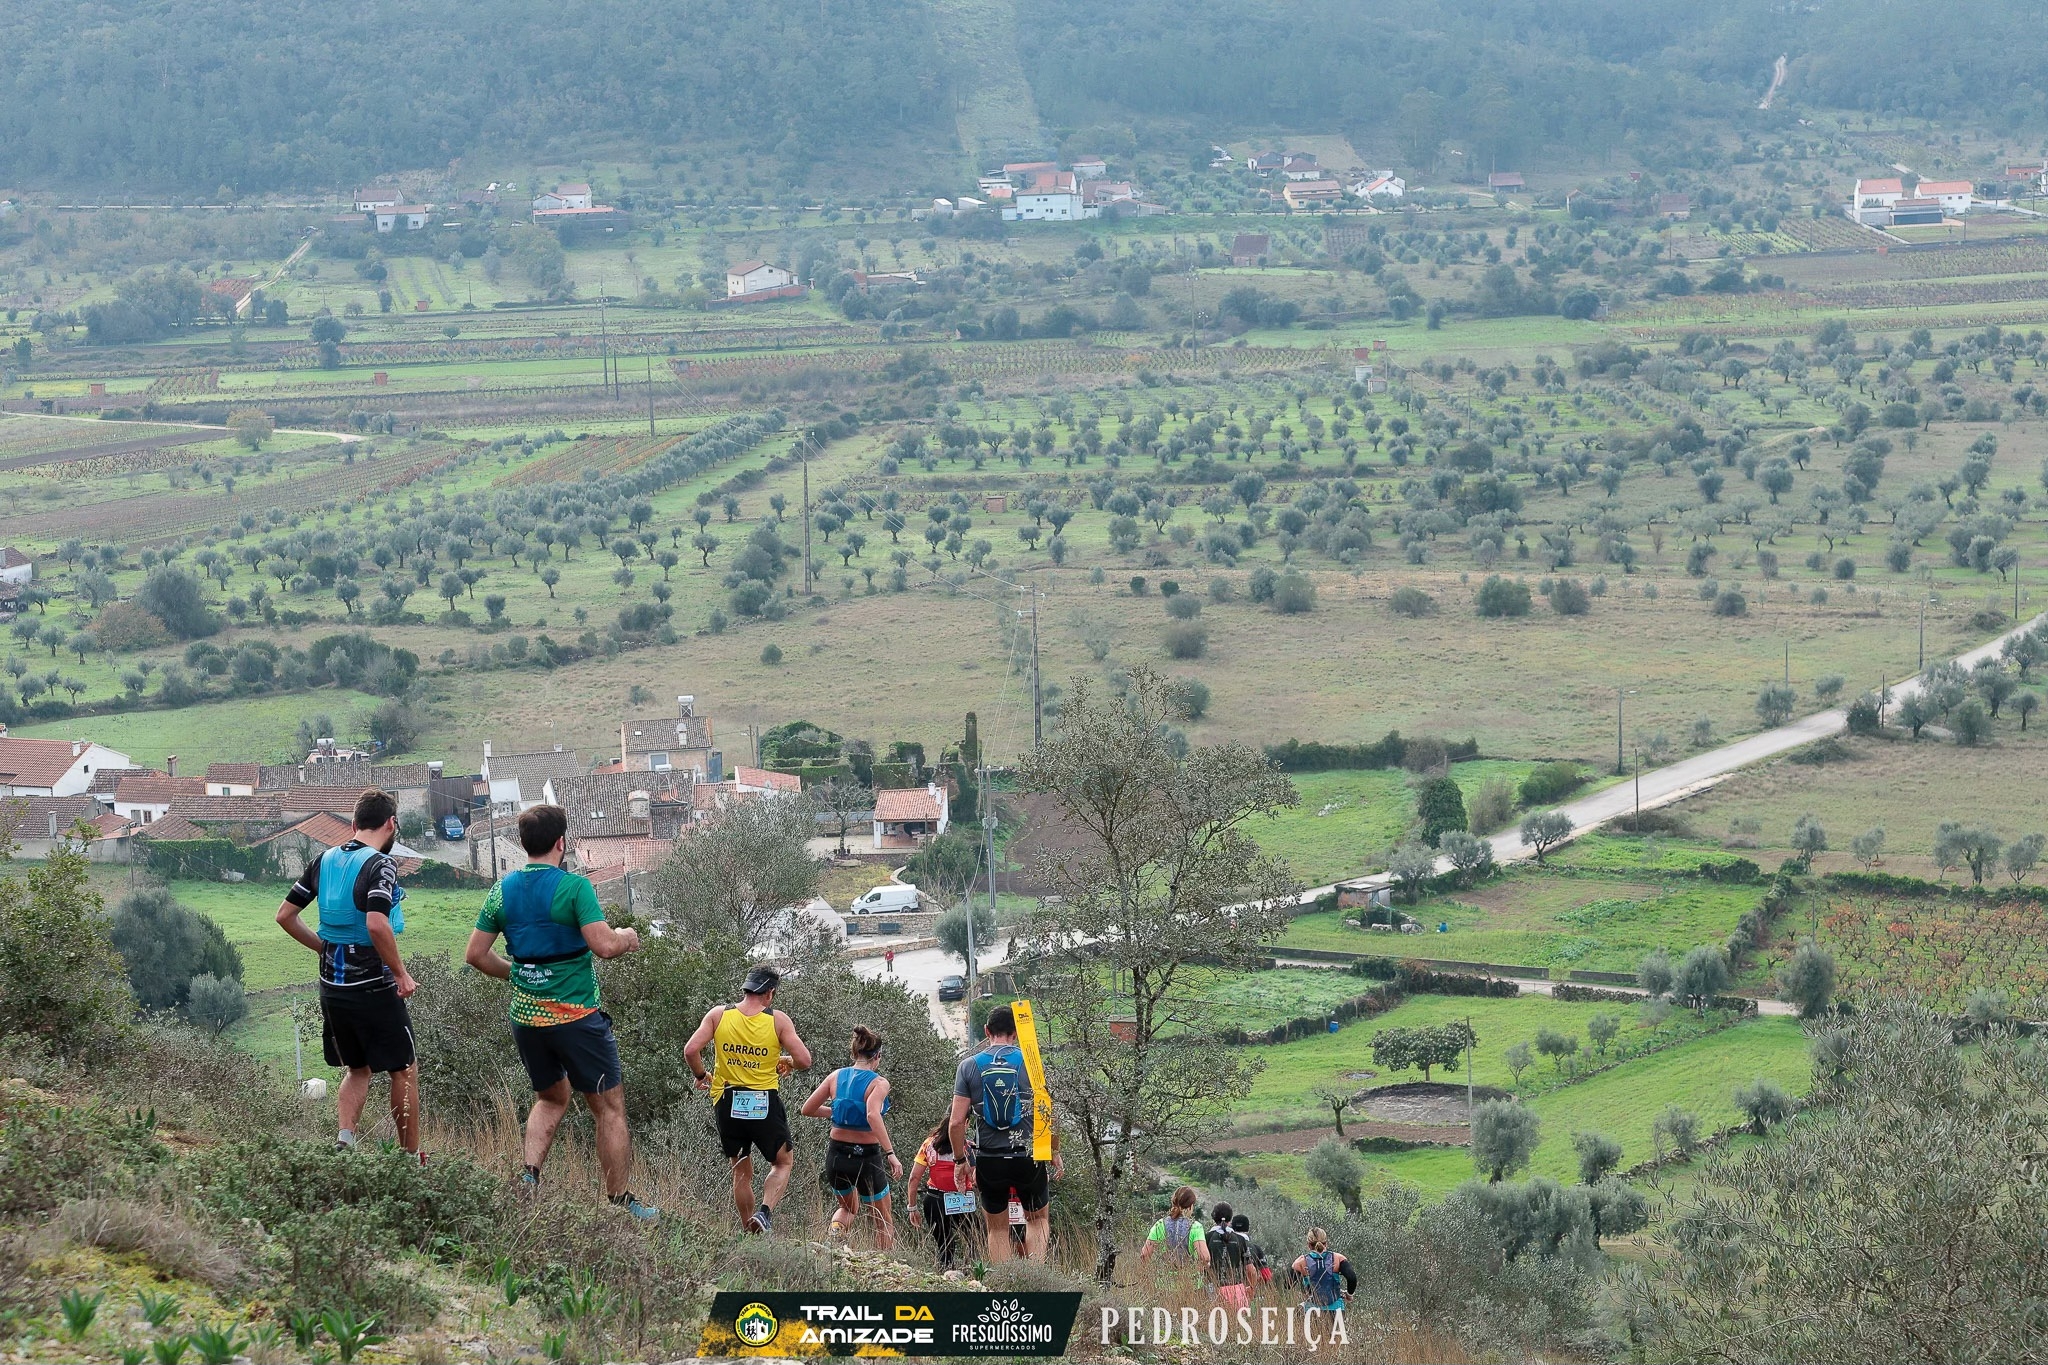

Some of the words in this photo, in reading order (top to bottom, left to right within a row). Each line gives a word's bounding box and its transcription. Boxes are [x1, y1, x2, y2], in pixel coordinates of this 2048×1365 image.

[722, 1042, 768, 1057] CARRACO
[743, 1060, 760, 1069] 2021
[736, 1097, 750, 1106] 727
[948, 1196, 961, 1204] 793
